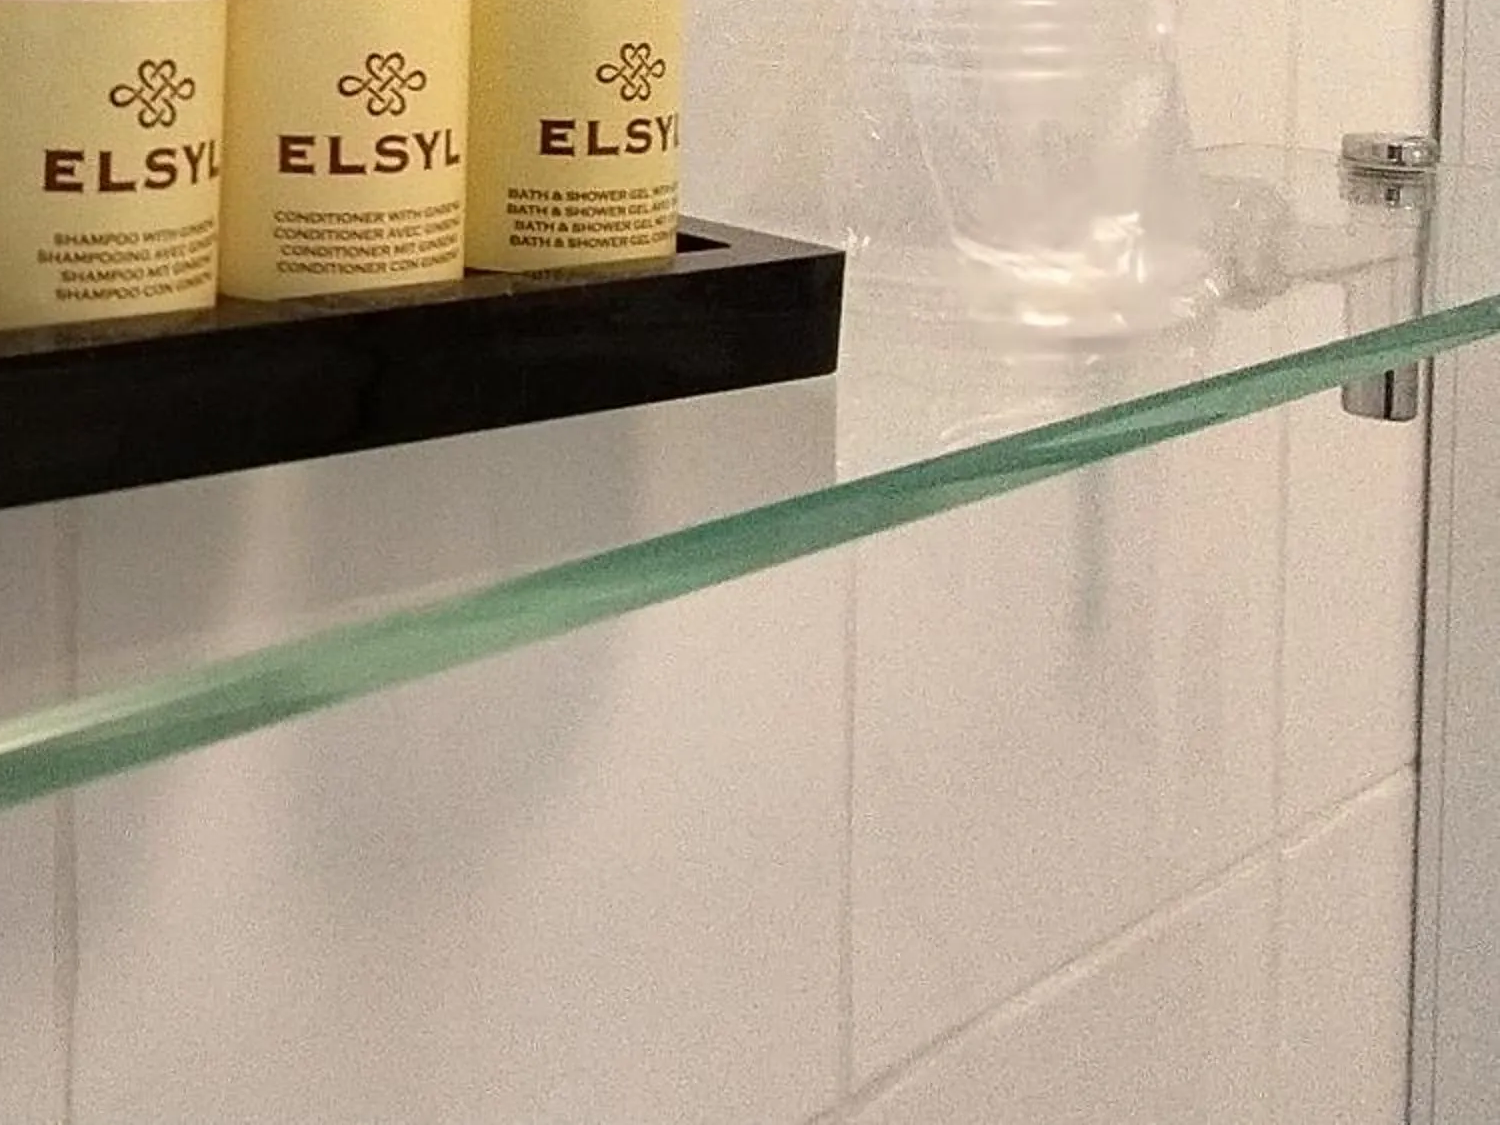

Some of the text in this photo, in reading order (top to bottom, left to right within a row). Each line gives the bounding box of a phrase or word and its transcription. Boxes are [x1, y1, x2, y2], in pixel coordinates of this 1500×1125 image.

[278, 129, 460, 174] ELSYL
[43, 139, 219, 193] ELSYL
[508, 187, 549, 200] BATH
[551, 189, 562, 201] &
[565, 189, 627, 202] SHOWER
[629, 188, 649, 199] GEL
[273, 210, 385, 224] CONDITIONER
[387, 209, 421, 221] WITH
[507, 203, 547, 215] BATH
[551, 205, 562, 216] &
[564, 205, 626, 217] SHOWER
[627, 204, 649, 215] GEL
[273, 225, 385, 240] CONDITIONER
[388, 225, 421, 238] AVEC
[515, 219, 555, 232] BATH
[558, 221, 569, 232] &
[571, 221, 631, 233] SHOWER
[633, 219, 654, 230] GEL
[53, 231, 140, 245] SHAMPOO
[510, 234, 550, 246] BATH
[553, 236, 565, 248] &
[567, 235, 628, 248] SHOWER
[630, 235, 651, 245] GEL
[37, 248, 150, 263] SHAMPOOING
[280, 244, 390, 257] CONDITIONER
[393, 242, 416, 254] MIT
[276, 260, 387, 273] CONDITIONER
[389, 257, 419, 271] CON
[61, 267, 144, 282] SHAMPOO
[56, 286, 141, 300] SHAMPOO
[143, 282, 173, 297] CON
